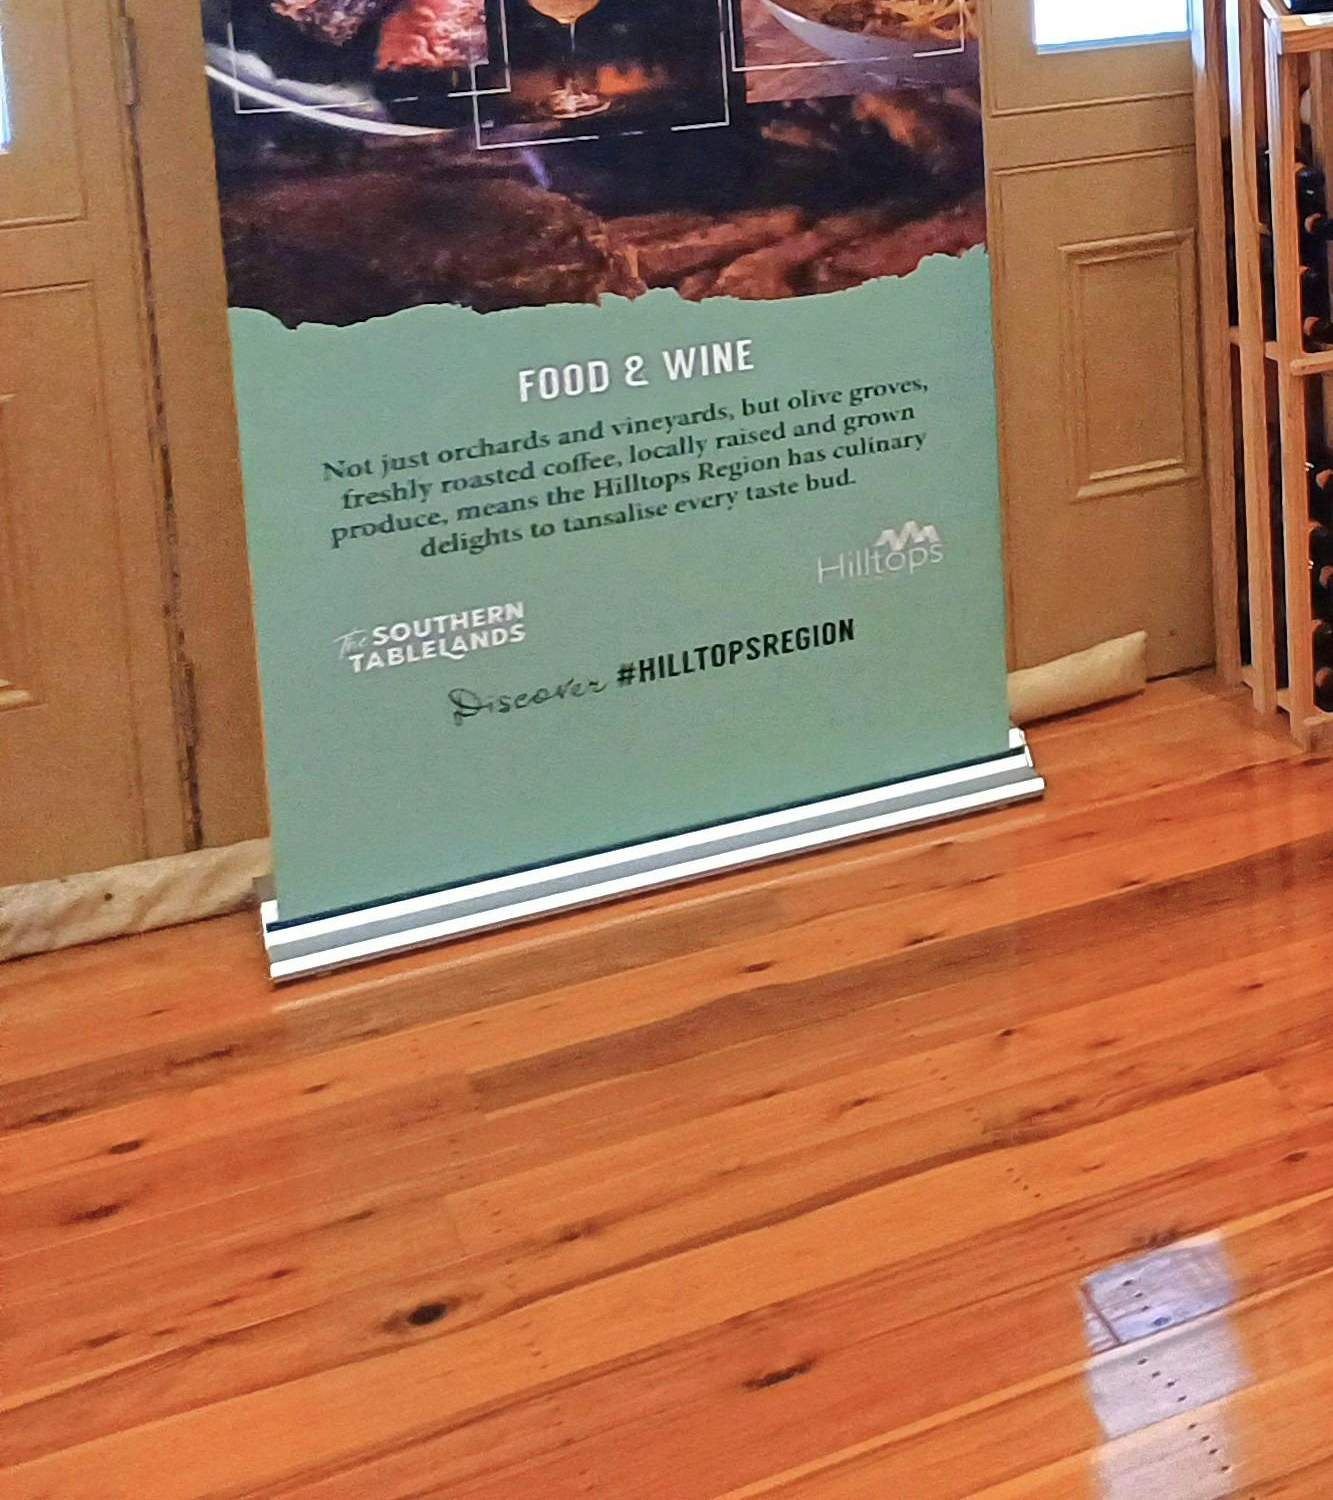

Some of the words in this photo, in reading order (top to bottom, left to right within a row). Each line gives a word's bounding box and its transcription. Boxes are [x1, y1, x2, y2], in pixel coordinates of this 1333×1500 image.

[519, 358, 611, 403] FOOD
[623, 354, 649, 388] &
[662, 339, 755, 381] WINE
[322, 458, 374, 481] Not
[380, 449, 430, 479] just
[437, 430, 551, 464] orchards
[557, 420, 604, 446] and
[610, 403, 735, 435] vineyards,
[741, 389, 780, 417] but
[788, 386, 843, 410] olive
[849, 376, 929, 407] groves,
[342, 478, 433, 510] freshly
[441, 460, 535, 494] roasted
[543, 451, 623, 476] coffee,
[629, 435, 707, 464] locally
[715, 421, 786, 450] raised
[793, 414, 836, 437] and
[843, 406, 915, 435] grown
[330, 510, 449, 549] produce,
[456, 494, 539, 521] means
[546, 485, 585, 507] the
[593, 467, 691, 500] Hilltops
[697, 454, 780, 483] Region
[787, 447, 826, 468] has
[832, 431, 927, 459] culinary
[420, 527, 523, 558] delights
[530, 521, 555, 538] to
[563, 501, 668, 534] tansalise
[675, 489, 738, 512] every
[746, 480, 799, 501] taste
[806, 468, 856, 491] bud.
[817, 541, 945, 584] Hilltops
[334, 628, 368, 661] The
[372, 602, 525, 646] SOUTHERN
[348, 623, 527, 673] TABLELANDS
[448, 675, 608, 727] Discover
[616, 618, 857, 686] #HILLTOPSREGION
